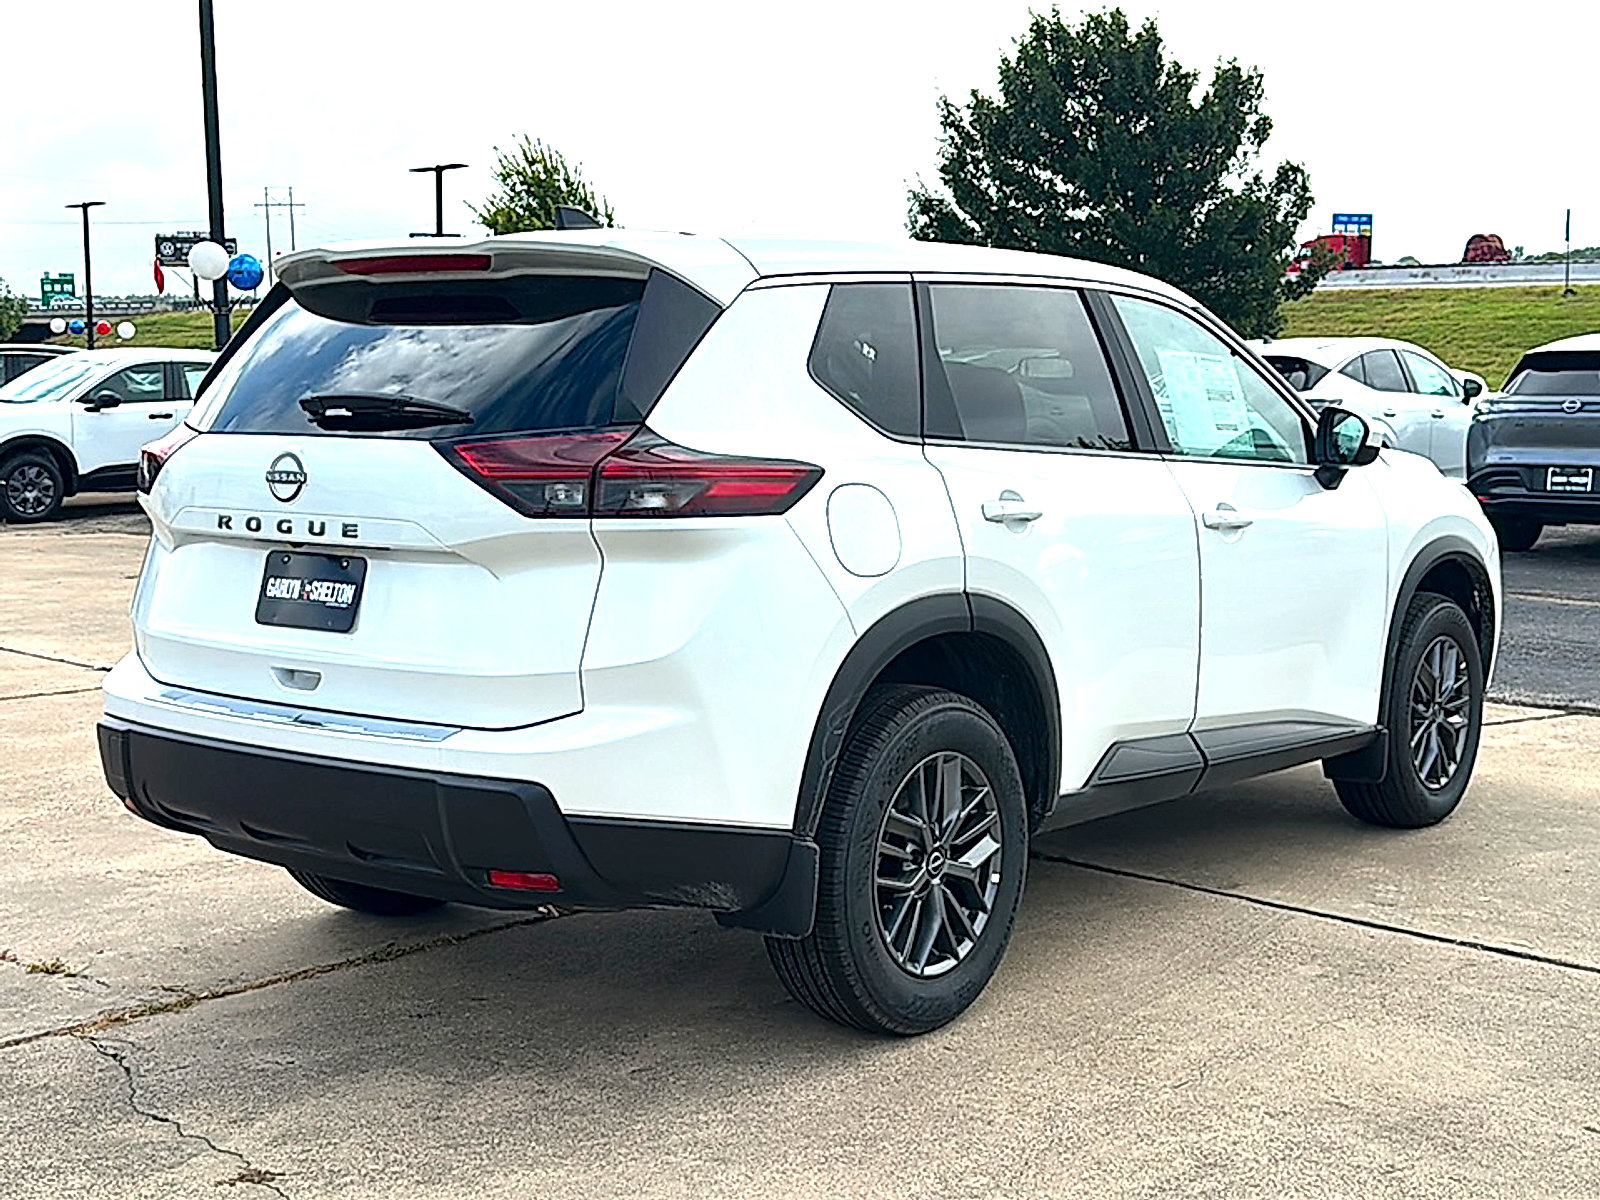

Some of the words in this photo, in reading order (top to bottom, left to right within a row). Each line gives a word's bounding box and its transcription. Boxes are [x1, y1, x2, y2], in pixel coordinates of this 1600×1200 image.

[266, 471, 306, 483] NISSAN
[217, 514, 359, 539] ROGUE
[309, 580, 357, 604] SHELTON
